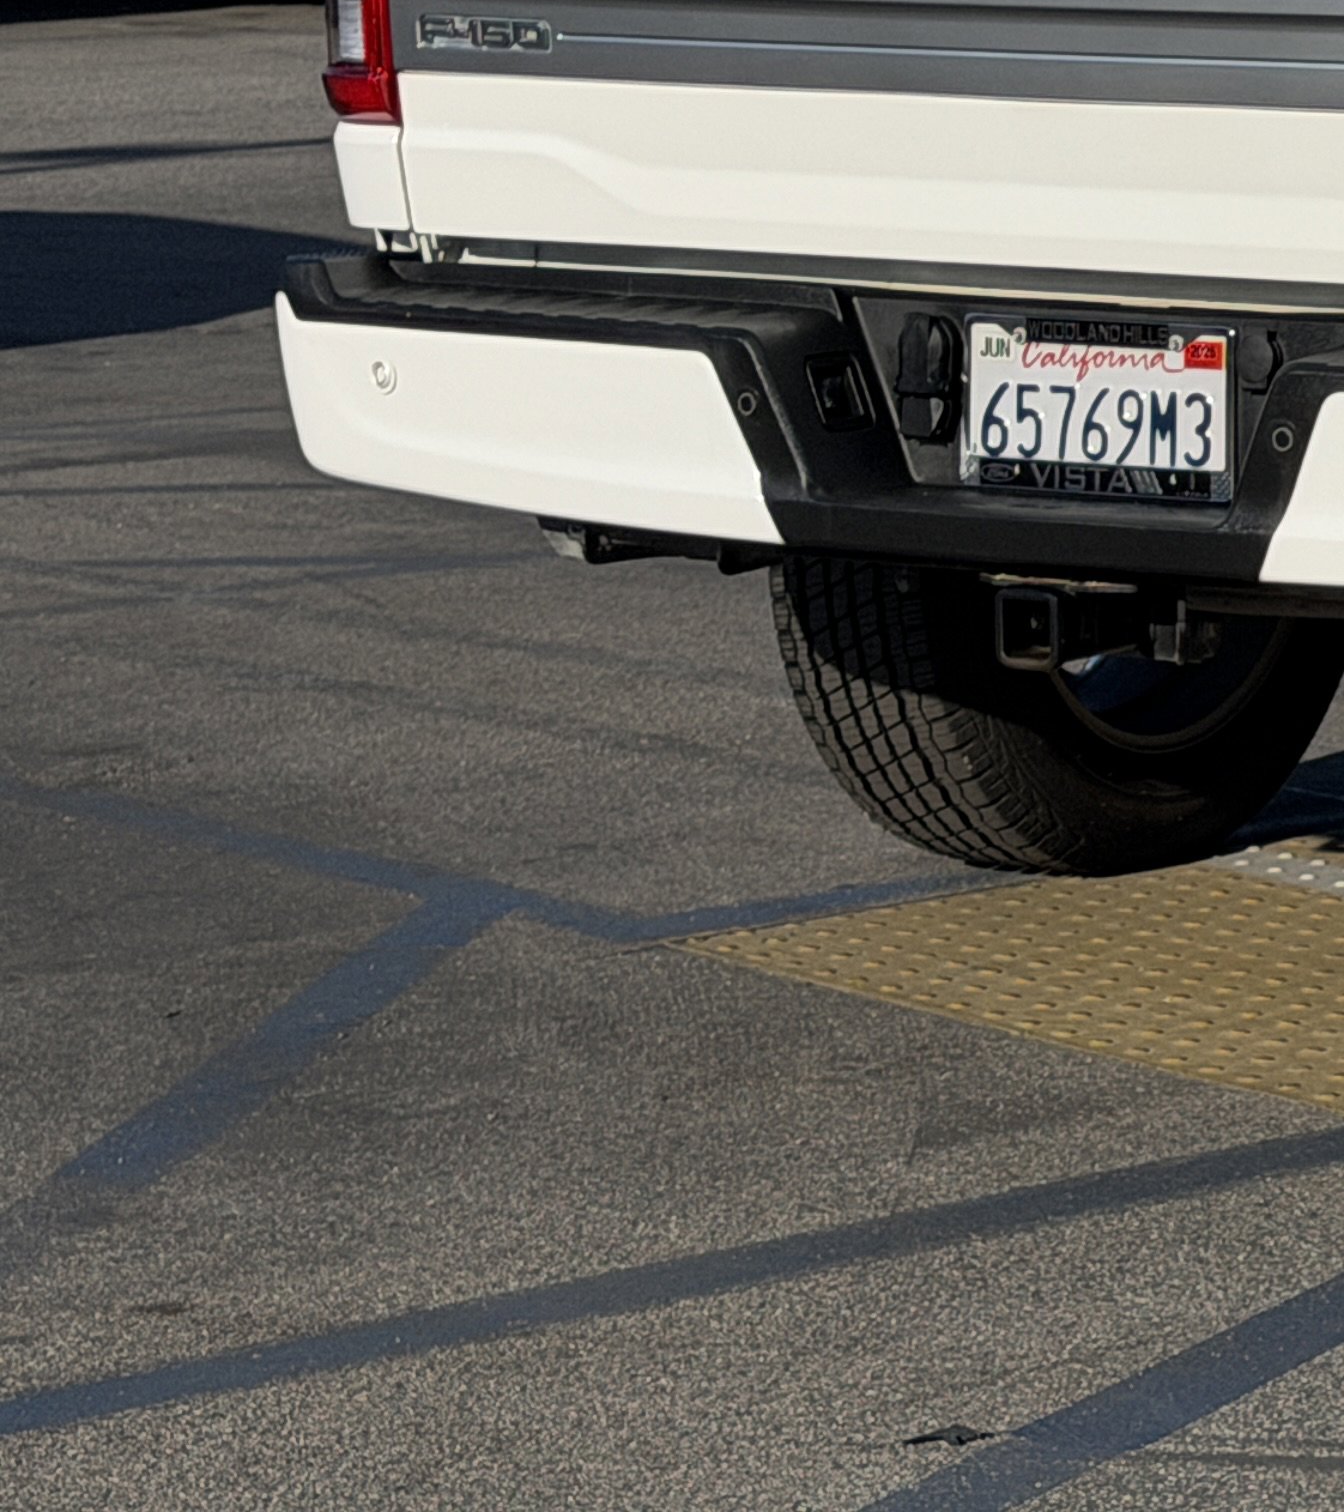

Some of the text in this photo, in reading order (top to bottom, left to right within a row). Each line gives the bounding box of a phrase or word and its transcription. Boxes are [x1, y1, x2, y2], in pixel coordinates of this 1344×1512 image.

[980, 336, 1011, 359] JUN
[1021, 342, 1183, 381] California
[980, 381, 1213, 467] 65769M3
[1030, 463, 1133, 493] VISTA
